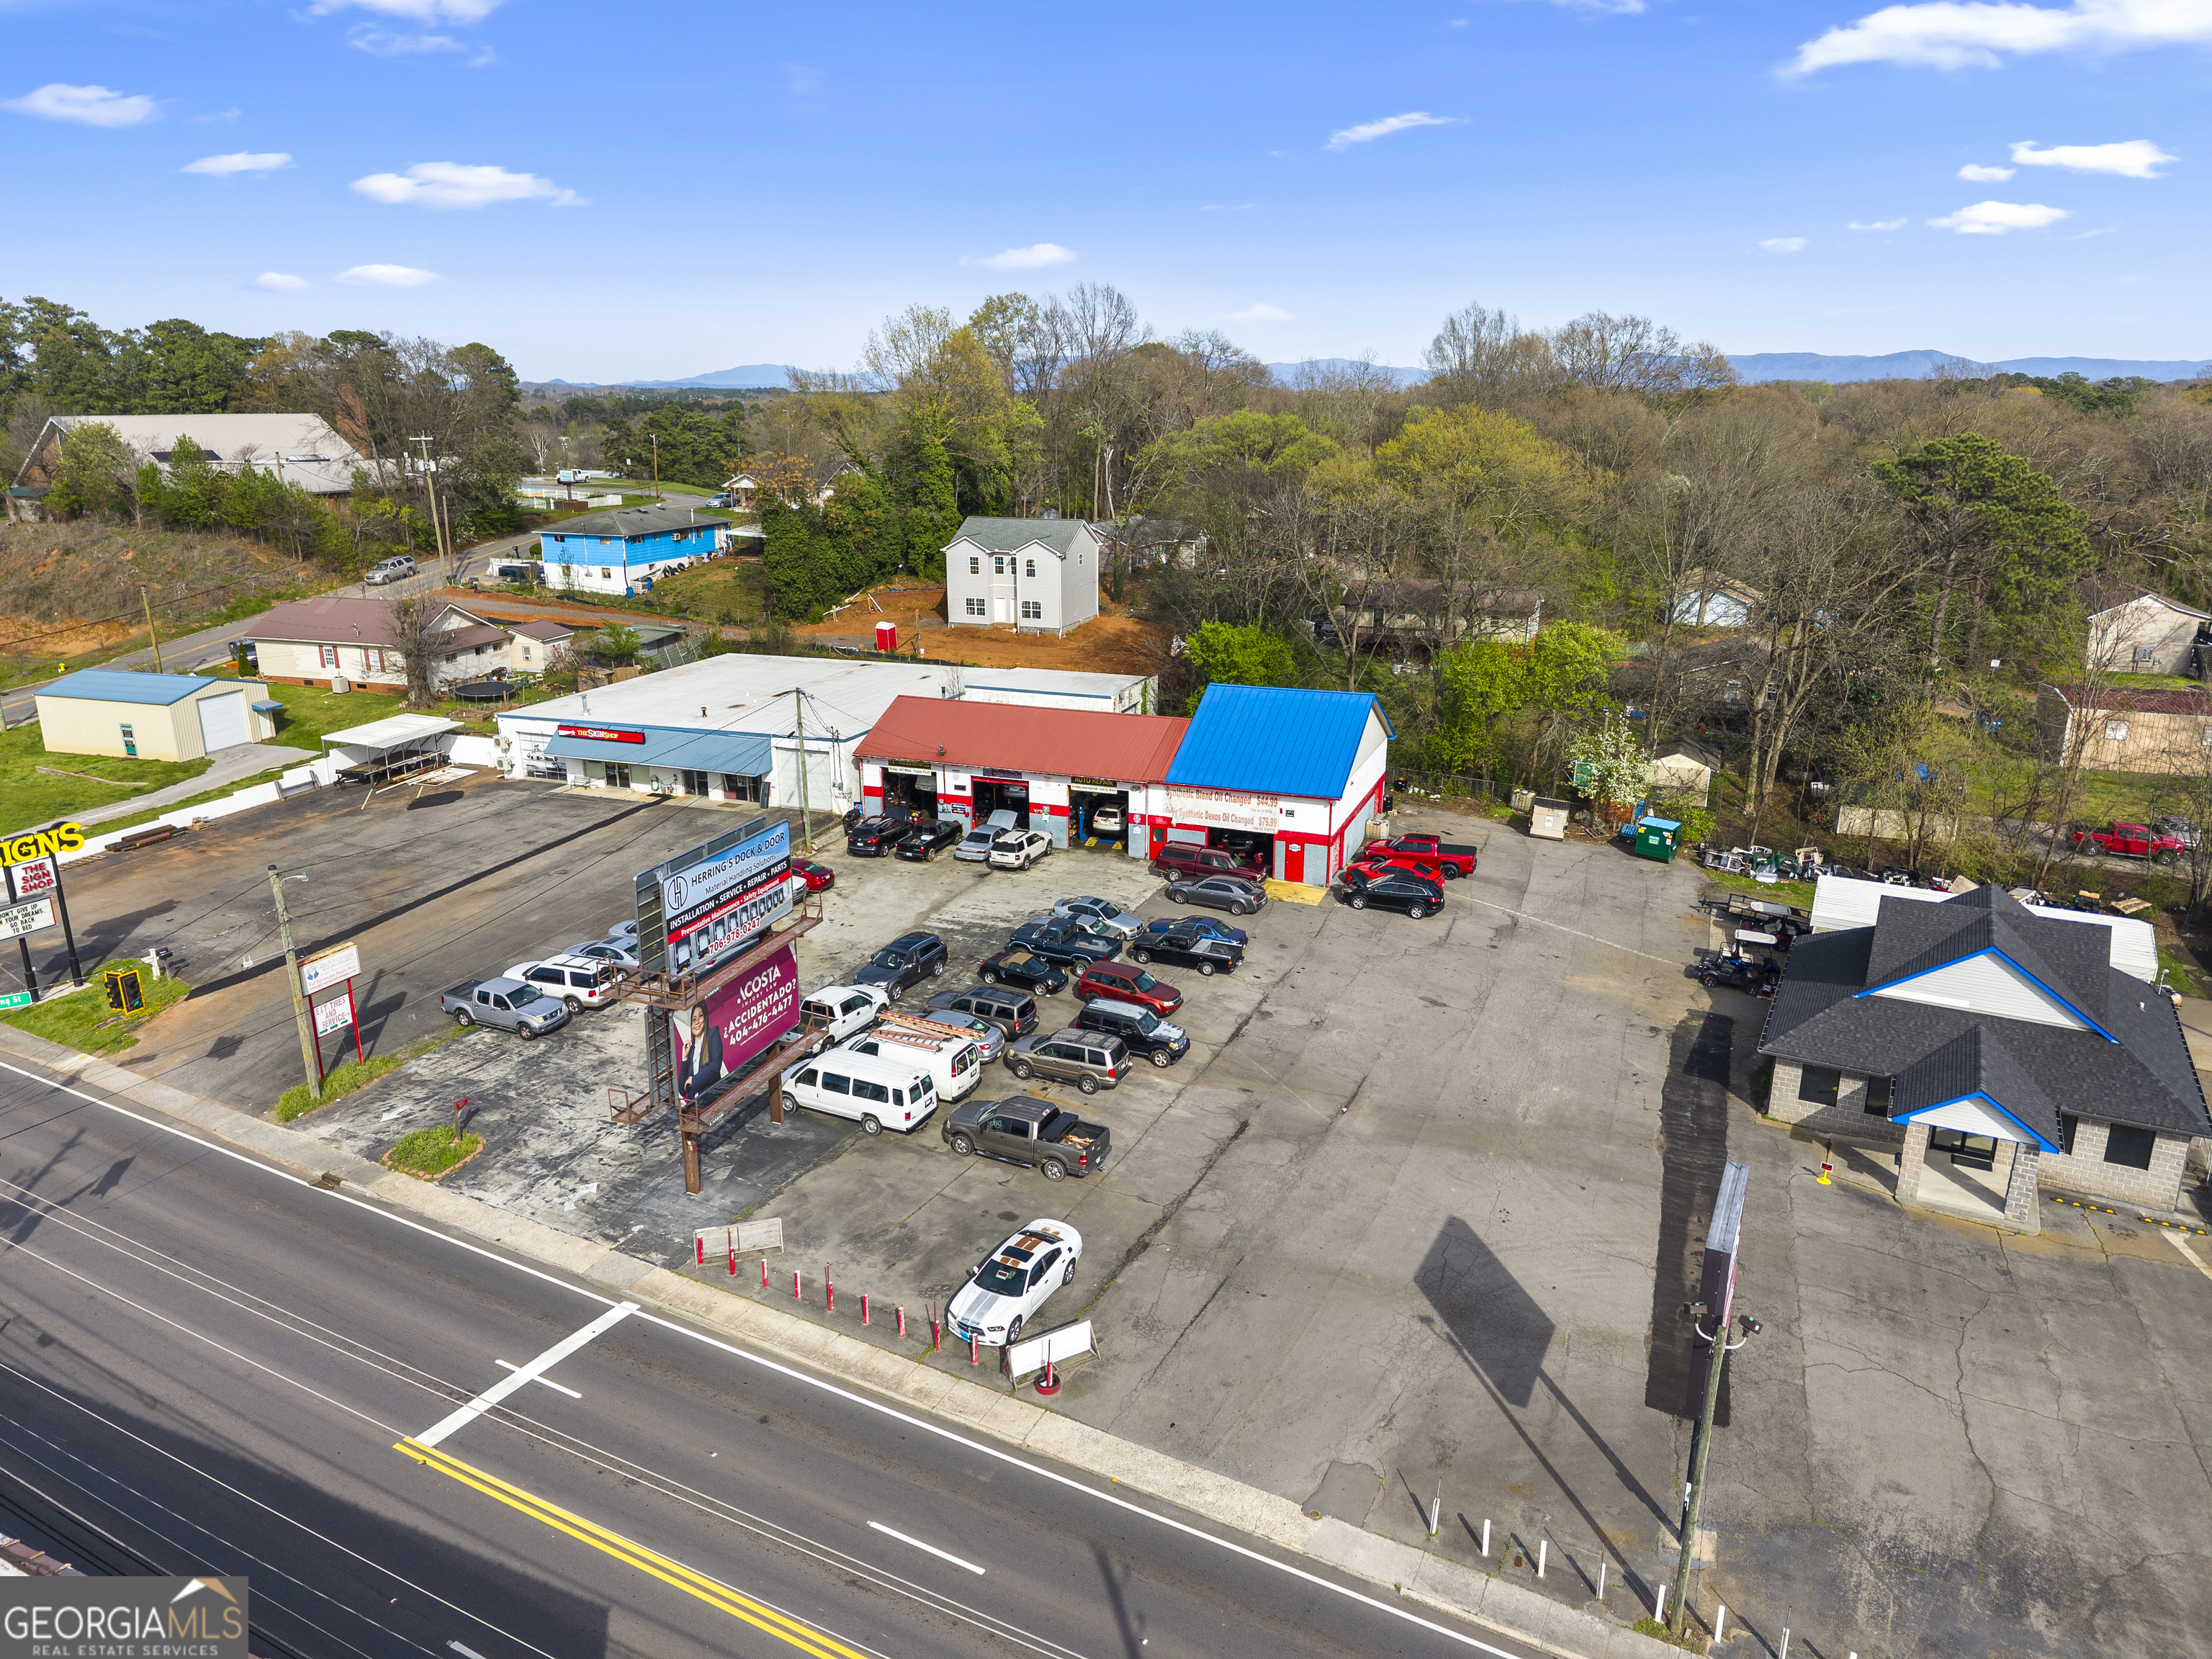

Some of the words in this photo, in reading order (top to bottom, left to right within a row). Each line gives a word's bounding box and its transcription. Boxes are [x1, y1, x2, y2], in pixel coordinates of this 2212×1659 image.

[588, 729, 605, 738] SIGN
[1166, 786, 1194, 799] Synthetic
[1196, 789, 1213, 801] Blend
[1214, 791, 1223, 801] Oil
[1224, 792, 1251, 806] Changed
[1256, 796, 1278, 807] $44.99
[1179, 807, 1203, 819] Synthetic
[1205, 810, 1220, 821] Dexos
[1231, 814, 1254, 827] Changed
[1259, 816, 1277, 827] $79.99
[0, 822, 85, 868] IGNS
[22, 862, 46, 875] THE
[691, 858, 733, 887] HERRING'S
[734, 846, 755, 865] DOCK
[757, 844, 763, 853] &
[765, 832, 785, 850] DOOR
[22, 870, 50, 884] SIGN
[705, 878, 728, 895] Material
[729, 866, 752, 883] Handling
[753, 853, 776, 870] Solutions
[21, 878, 54, 894] SHOP
[670, 899, 715, 930] INSTALLATION
[719, 884, 743, 903] SERVICE
[747, 872, 767, 888] REPAIR
[770, 860, 788, 876] PARTS
[680, 917, 711, 936] Preventative
[711, 901, 740, 919] Maintenance
[743, 891, 757, 902] Safety
[757, 878, 780, 895] Equipment
[20, 917, 35, 925] BACK
[709, 916, 761, 956] 706-978-0247
[742, 991, 763, 1008] INJURY
[766, 981, 777, 992] LAW
[315, 1004, 328, 1015] E&T
[329, 996, 346, 1010] TIRES
[325, 1008, 336, 1020] AND
[723, 978, 796, 1038] ¿ACCIDENTADO?
[322, 1012, 346, 1029] SERVICE
[729, 994, 792, 1046] 404-476-4477
